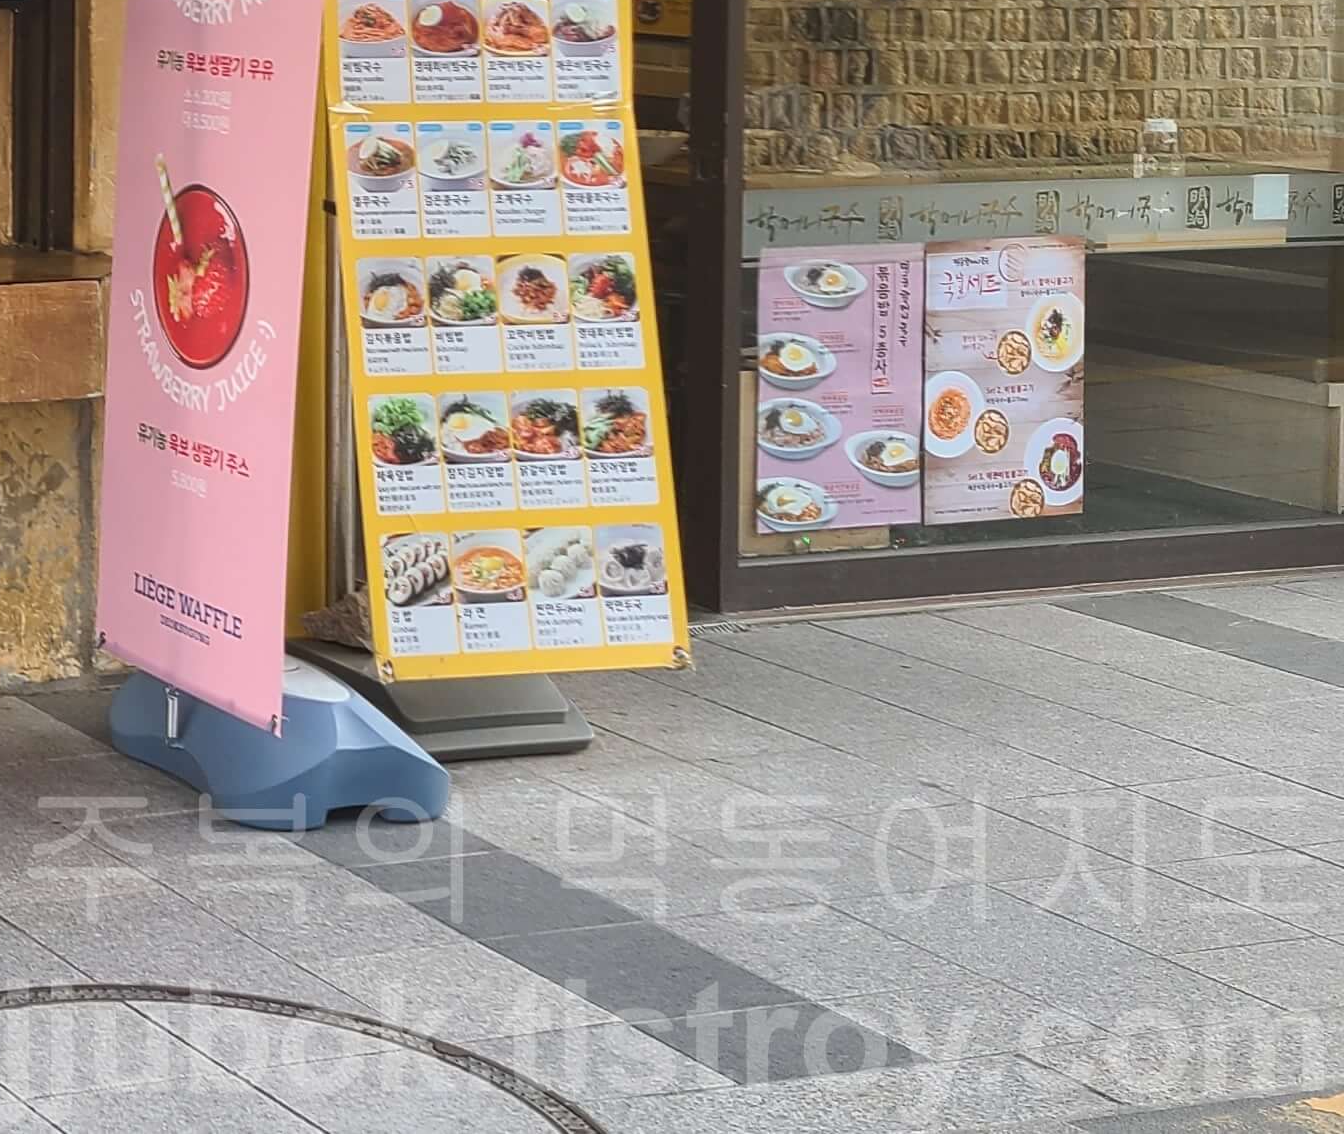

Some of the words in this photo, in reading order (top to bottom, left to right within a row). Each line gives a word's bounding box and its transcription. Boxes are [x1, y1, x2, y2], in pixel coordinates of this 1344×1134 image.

[208, 53, 246, 79] 생딸기
[247, 57, 275, 82] 우유
[127, 287, 211, 415] STRAWBERRY
[214, 338, 268, 413] JUICE
[168, 432, 189, 457] 육보
[191, 441, 224, 471] 생딸기
[225, 452, 251, 478] 주스
[133, 570, 176, 611] LIÈGE
[178, 591, 243, 639] WAFFLE
